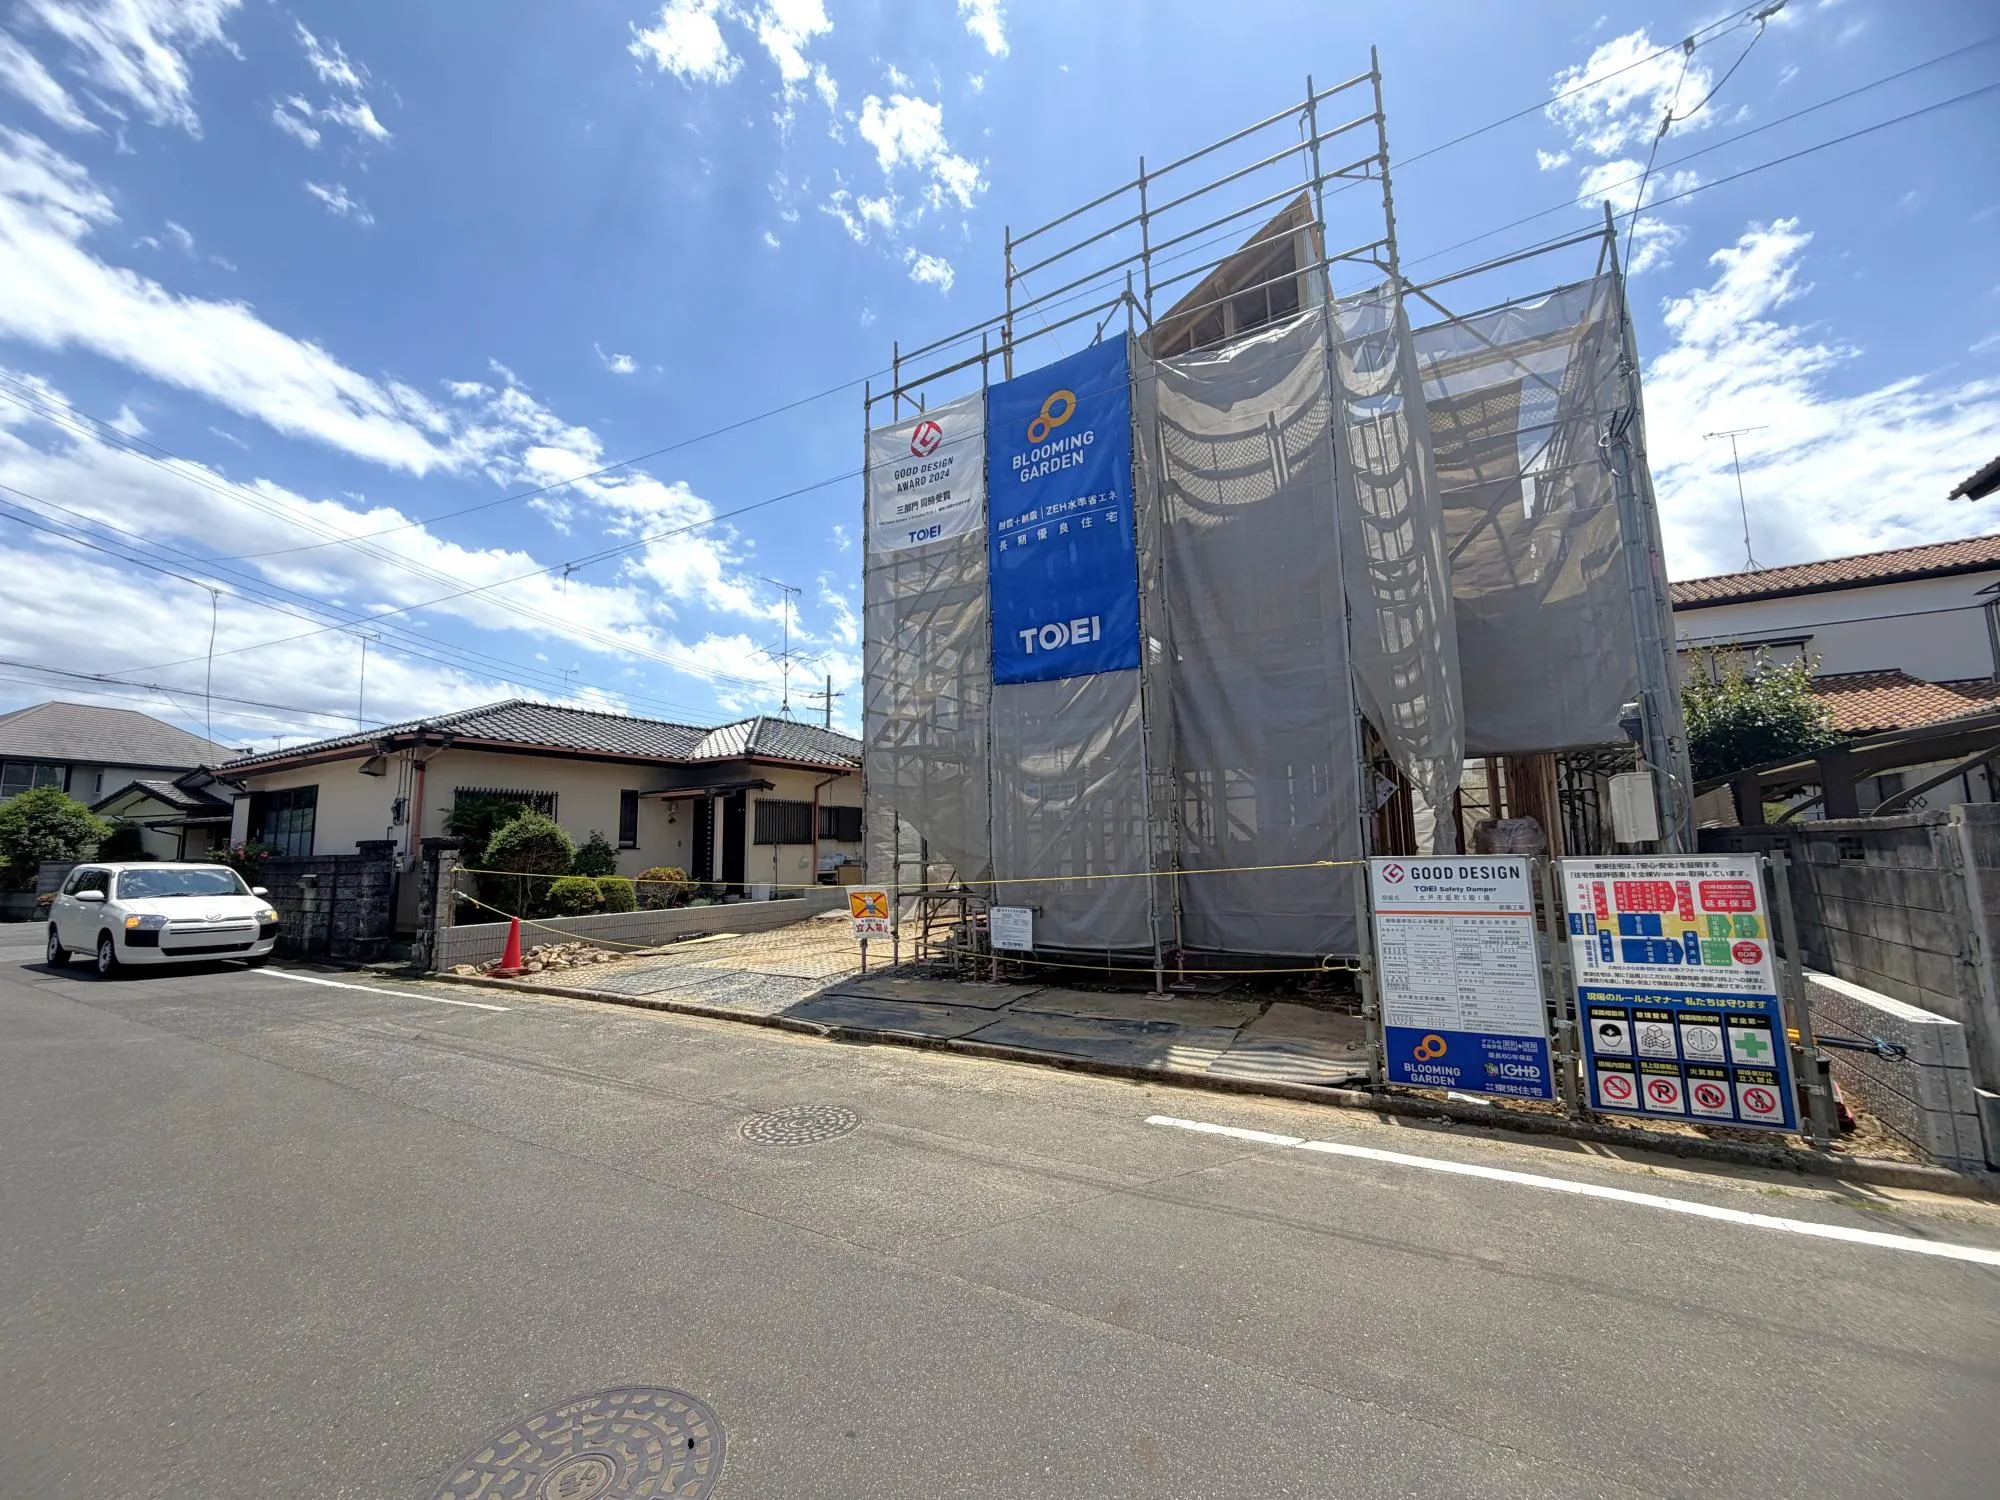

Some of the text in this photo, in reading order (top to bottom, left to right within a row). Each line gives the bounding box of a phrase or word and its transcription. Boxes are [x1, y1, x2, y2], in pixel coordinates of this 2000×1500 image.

[1012, 430, 1094, 470] BLOOMING
[894, 456, 954, 480] GOOD DESIGN
[1020, 450, 1084, 482] GARDEN
[897, 469, 950, 493] AWARD 2024
[896, 500, 919, 515] 三部門
[920, 490, 951, 509] 同時受賞
[1046, 490, 1117, 516] ZEH水準省エネ
[908, 524, 941, 543] TOEI
[999, 511, 1118, 552] 長期優良住宅
[1019, 615, 1101, 654] TOEI
[1411, 865, 1520, 880] GOOD DESIGN
[1705, 899, 1752, 908] 延長保証
[856, 923, 888, 933] 立入禁止
[1586, 992, 1767, 1009] 現場のルールとマナー 私たちは守ります
[1730, 1017, 1766, 1025] 安全第一
[1404, 1062, 1461, 1077] BLOOMING
[1410, 1073, 1456, 1086] GARDEN
[1739, 1076, 1775, 1084] 立入禁止
[1495, 1083, 1543, 1096] 東栄住宅
